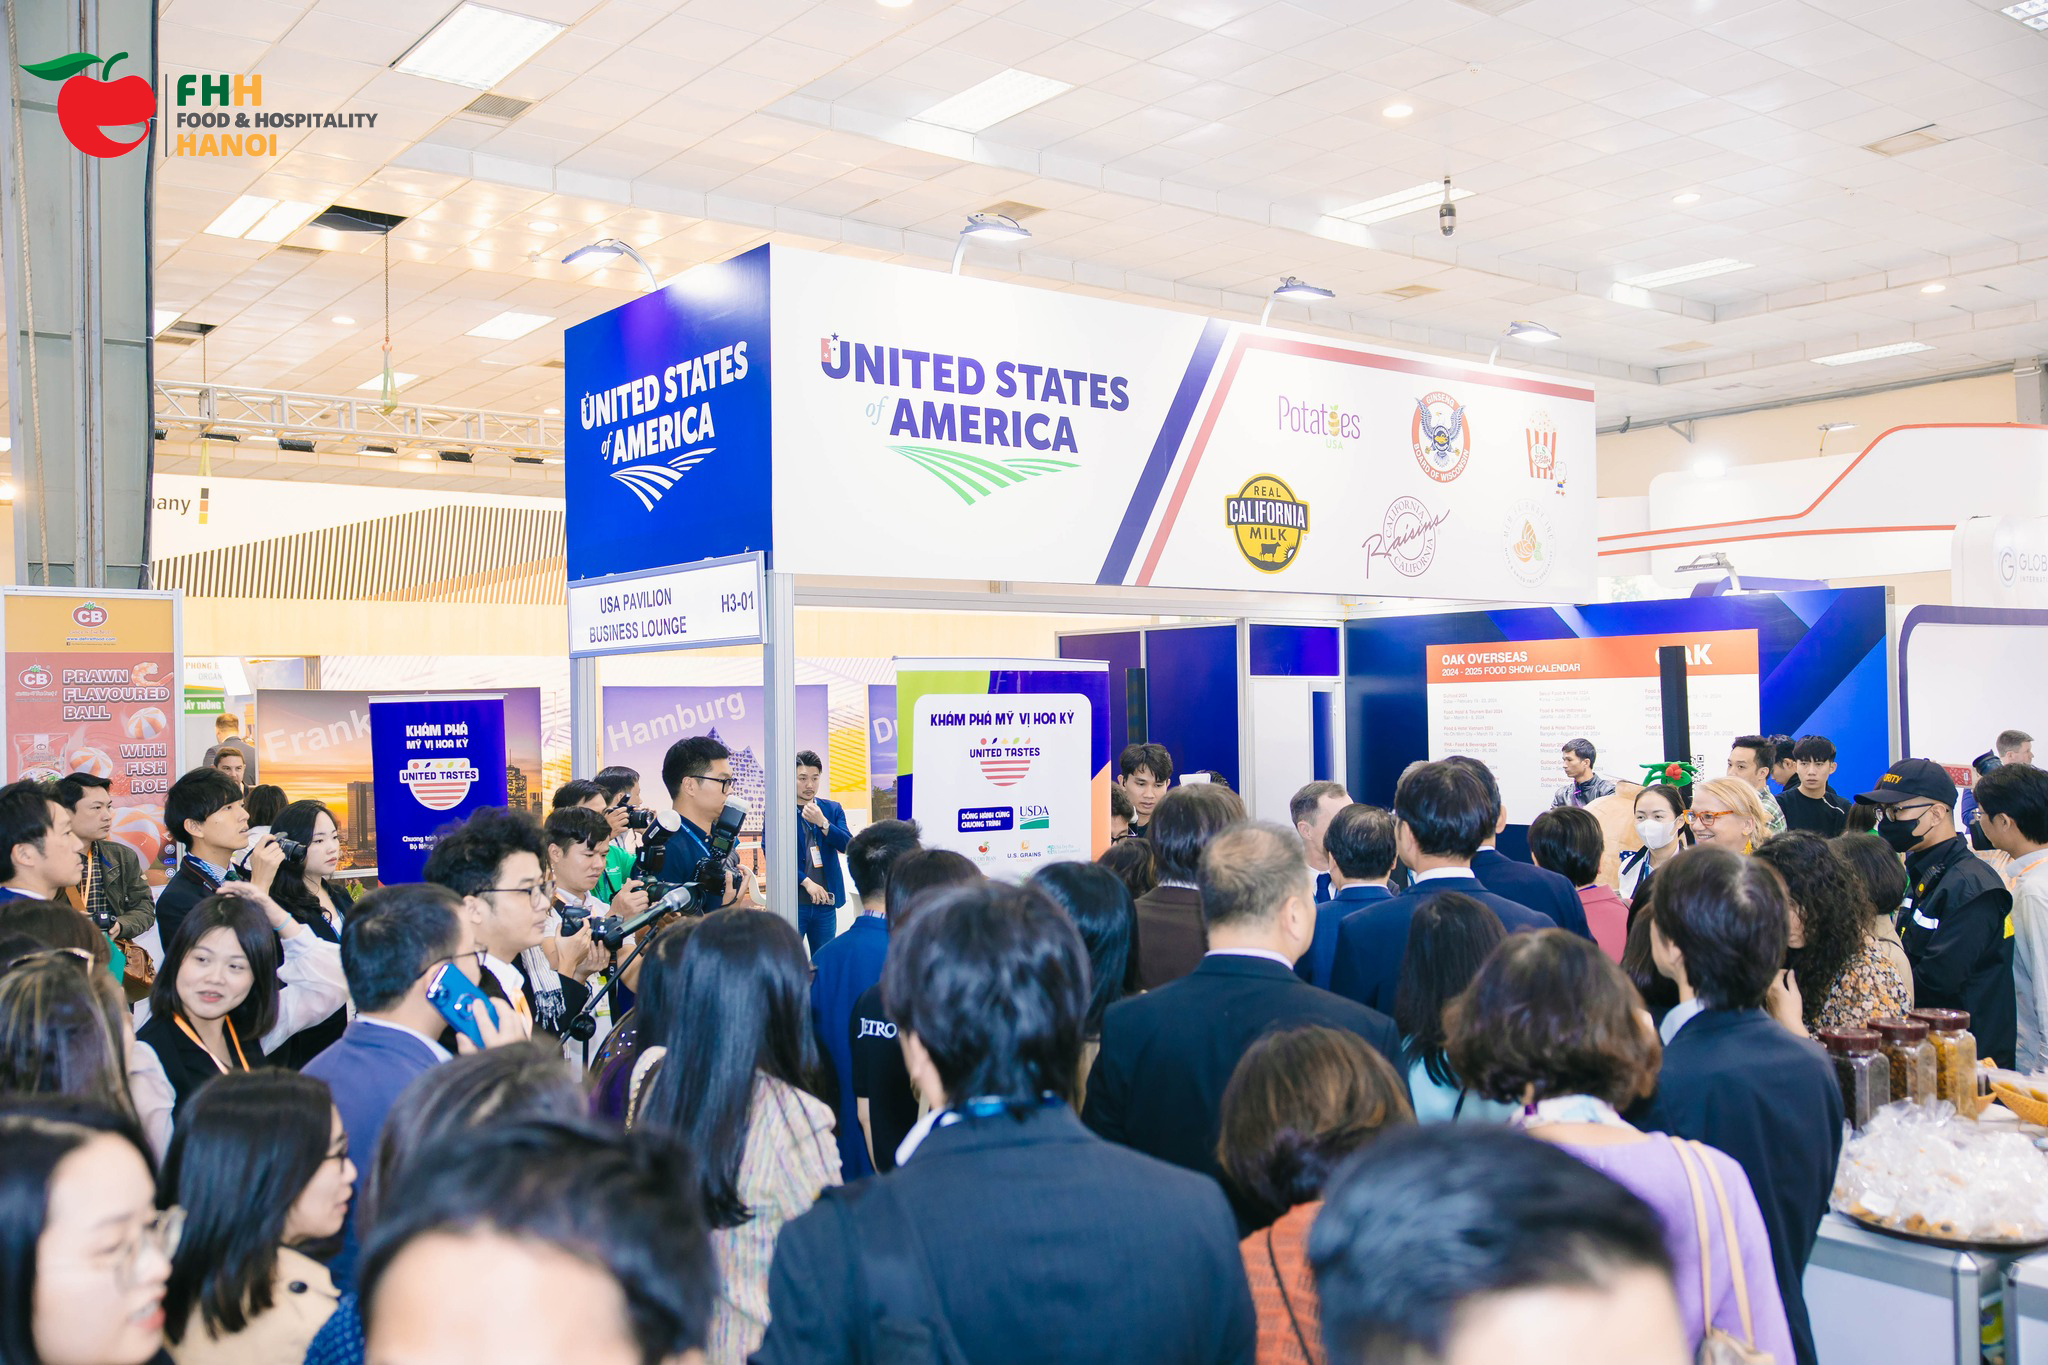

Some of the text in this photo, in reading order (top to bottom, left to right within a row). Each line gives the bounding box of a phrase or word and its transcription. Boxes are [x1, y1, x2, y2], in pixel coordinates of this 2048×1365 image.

[820, 334, 1130, 412] UNITED STATES
[580, 340, 749, 430] UNITED STATES
[1426, 393, 1455, 407] GINSENG
[865, 395, 1079, 454] of AMERICA
[601, 401, 715, 465] of AMERICA
[1326, 439, 1344, 450] USA
[1414, 443, 1470, 481] BOARD OF WISCONSIN
[1254, 485, 1281, 497] REAL
[152, 497, 191, 516] any
[1229, 500, 1305, 528] CALIFORNIA
[1386, 500, 1424, 539] CALIFORNIA
[1250, 526, 1287, 541] MILK
[1362, 509, 1451, 579] Raisins
[1394, 538, 1433, 573] CALIFORNIA
[2019, 553, 2048, 572] GLOB
[600, 587, 672, 614] USA PAVILION
[721, 590, 754, 613] H3-01
[77, 610, 103, 623] CB
[589, 616, 687, 643] BUSINESS LOUNGE
[1442, 651, 1528, 666] OAK OVERSEAS
[62, 669, 129, 685] PRAWN
[1442, 668, 1459, 676] 2024
[1465, 667, 1482, 676] 2025
[1484, 666, 1507, 675] FOOD
[1508, 665, 1533, 675] SHOW
[1535, 663, 1580, 674] CALENDAR
[23, 673, 48, 685] CB
[62, 686, 170, 702] FLAVOURED
[62, 705, 111, 721] BALL
[930, 709, 1075, 728] KHÁM PHÁ MỸ VỊ HOA KỲ
[405, 721, 468, 737] KHÁM PHÁ
[607, 691, 746, 753] Hamburg
[263, 709, 372, 763] Frank
[406, 737, 469, 751] MỸ VỊ HOA KỲ
[120, 743, 167, 758] WITH
[969, 748, 1041, 758] UNITED TASTES
[126, 761, 167, 775] FISH
[402, 770, 477, 781] UNITED TASTES
[131, 779, 168, 794] ROE
[1020, 806, 1050, 817] USDA
[857, 1017, 898, 1039] JETRO
